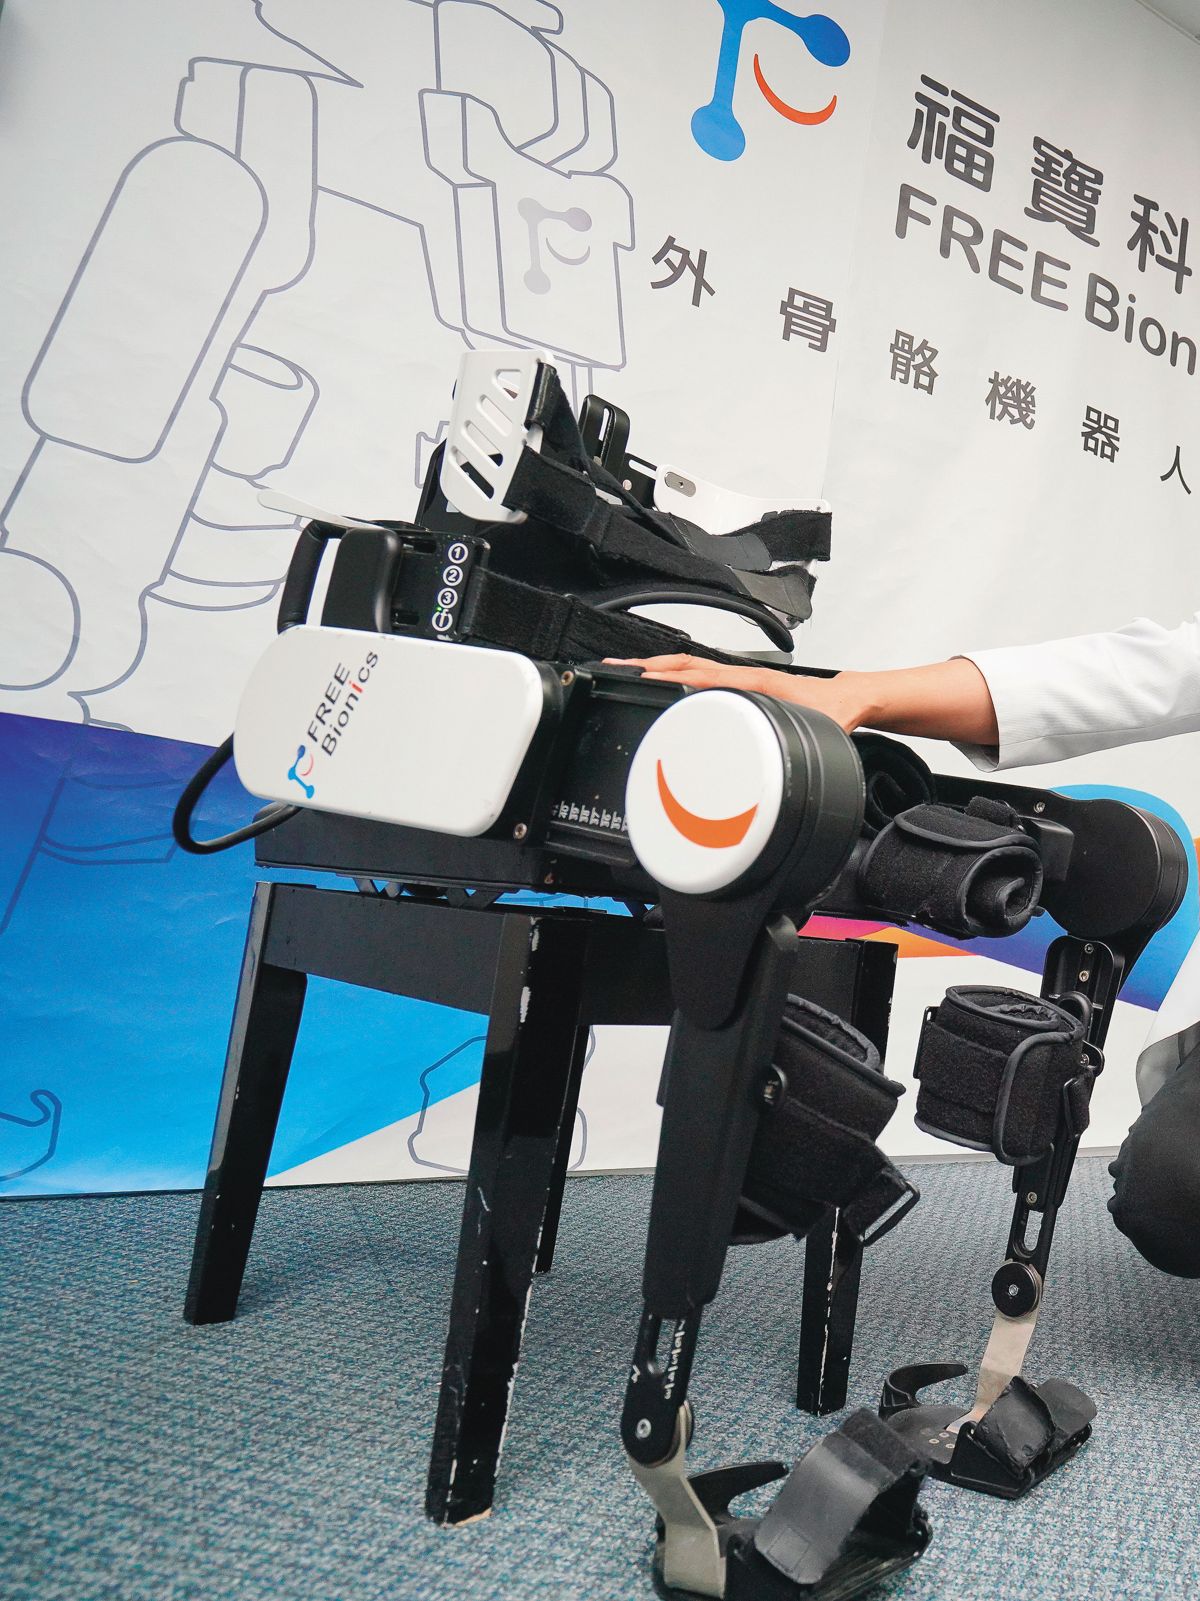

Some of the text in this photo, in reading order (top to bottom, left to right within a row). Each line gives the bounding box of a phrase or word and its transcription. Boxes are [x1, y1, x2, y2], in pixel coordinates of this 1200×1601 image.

[894, 183, 1072, 312] FREE
[307, 662, 350, 743] FREE
[321, 651, 379, 756] Bionics
